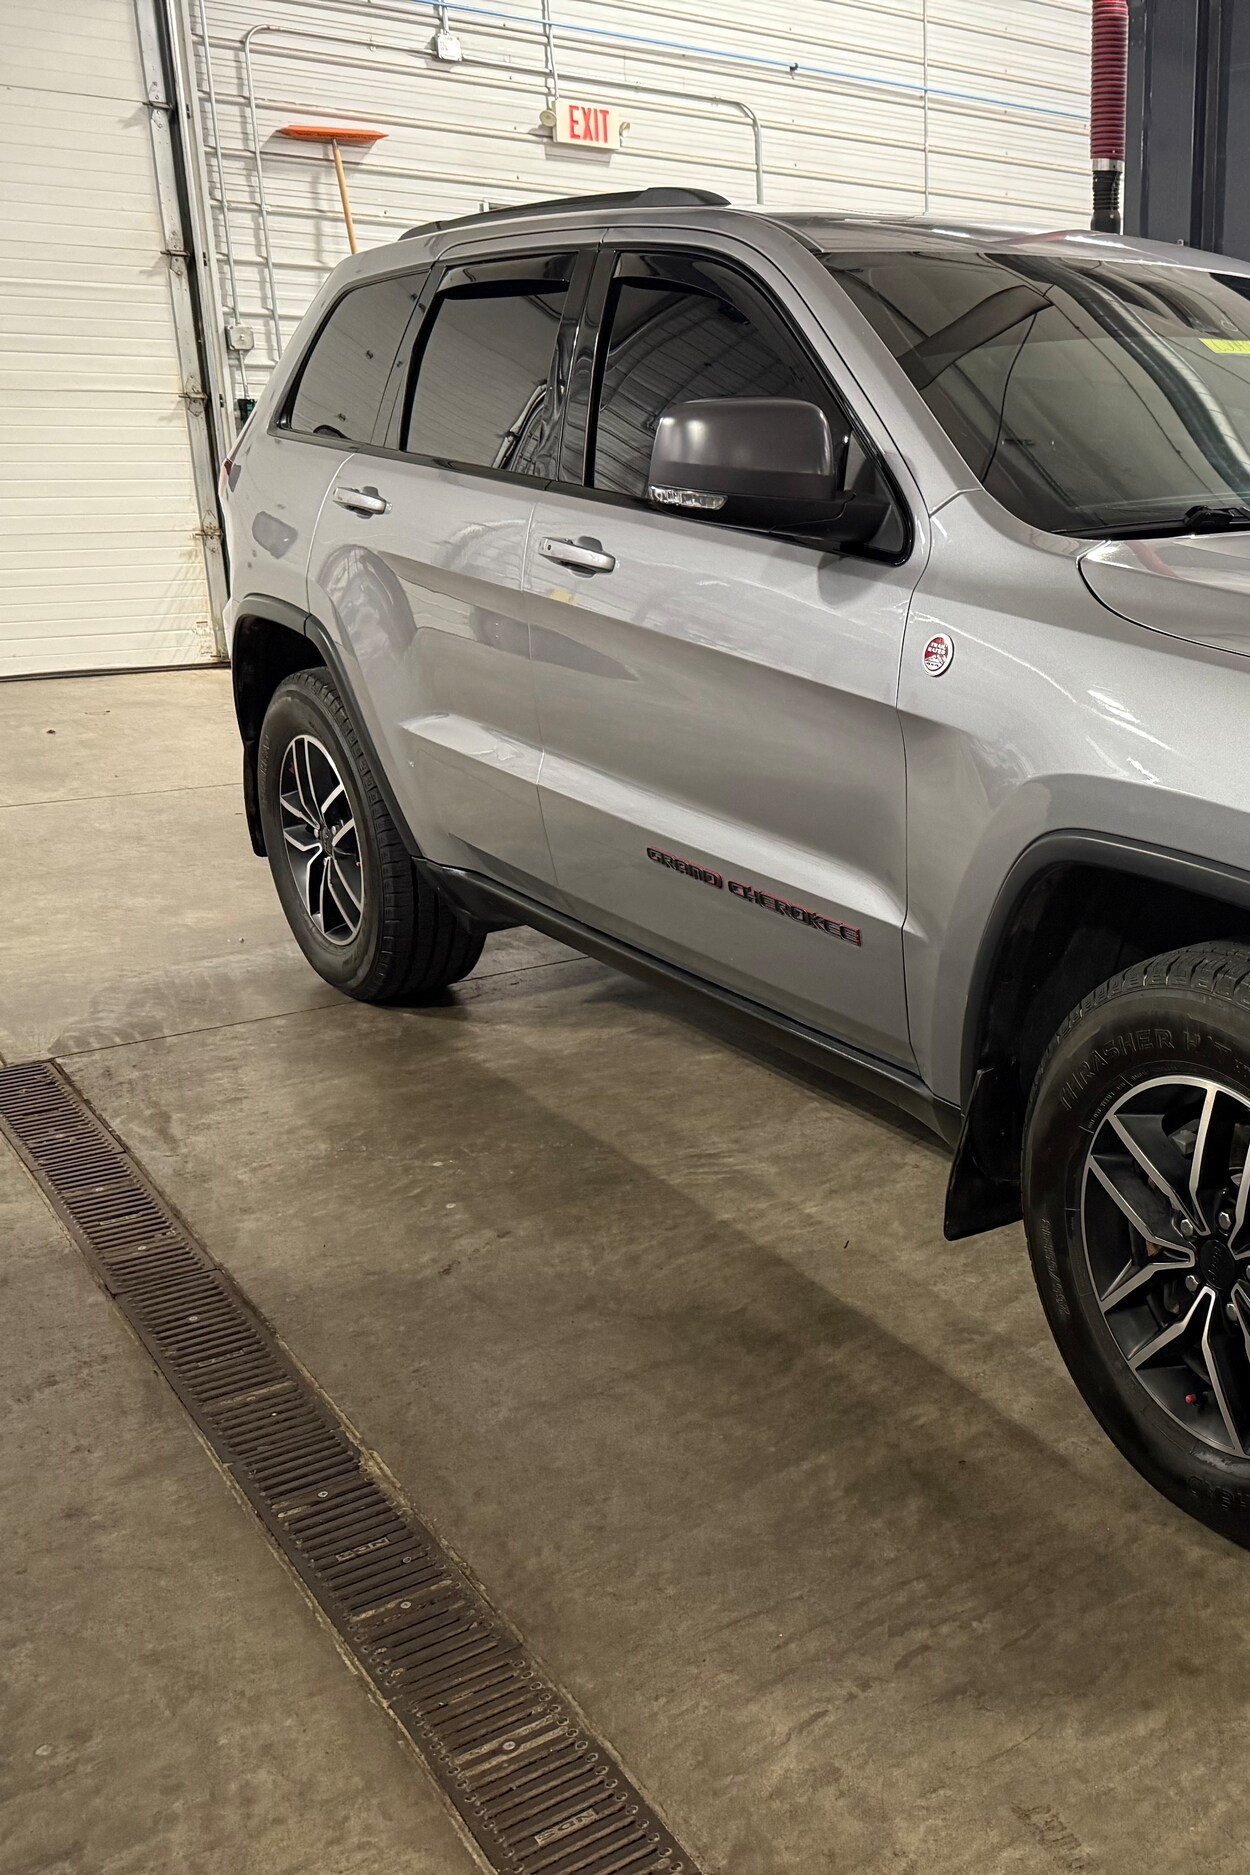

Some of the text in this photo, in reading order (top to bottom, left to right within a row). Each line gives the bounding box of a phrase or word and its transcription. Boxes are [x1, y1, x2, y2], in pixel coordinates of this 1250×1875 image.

[568, 104, 610, 144] EXIT
[646, 845, 862, 948] GRAND CHEROKEE
[1056, 1027, 1177, 1112] THRASHER
